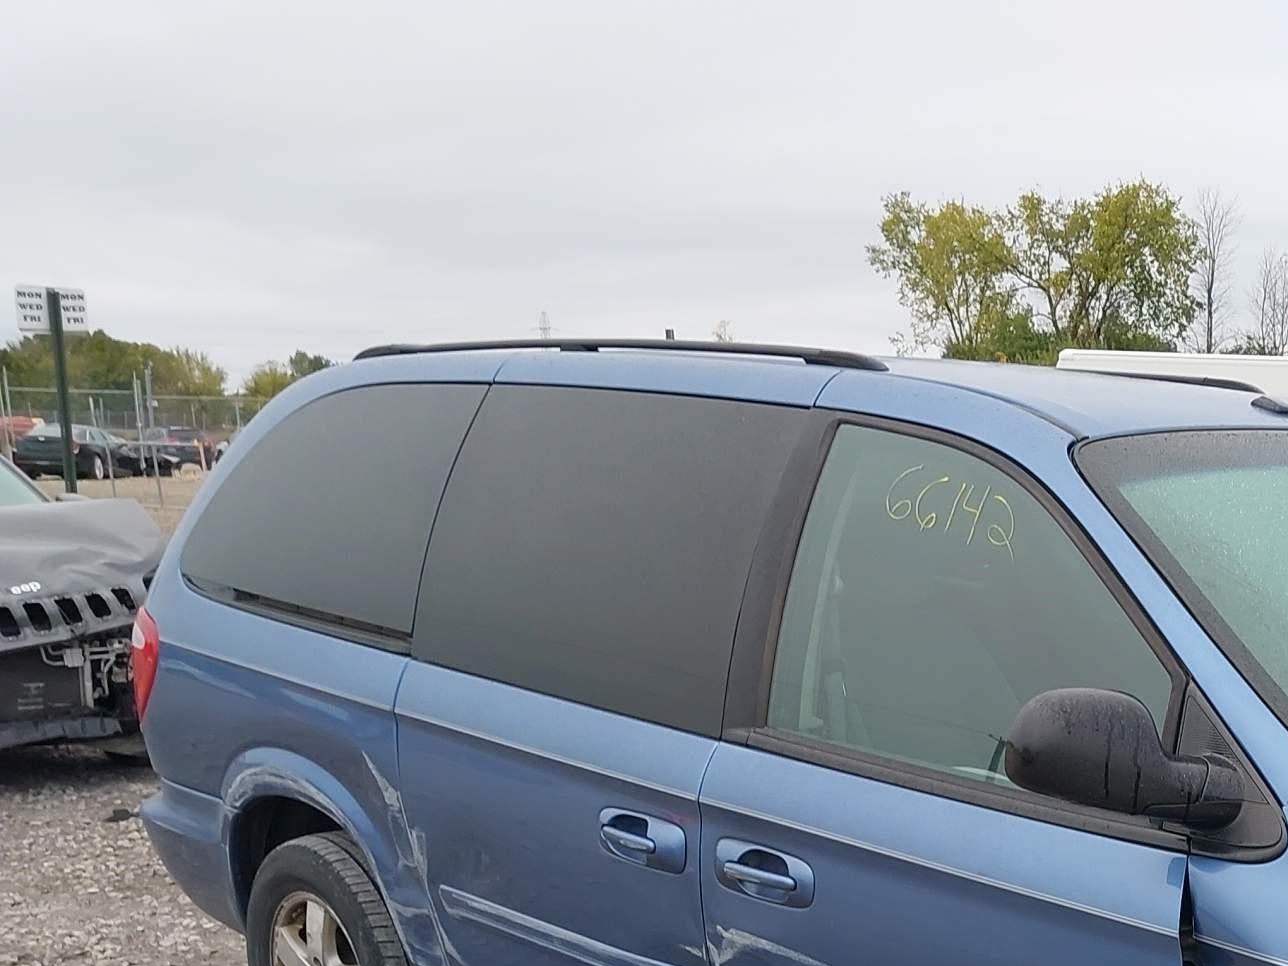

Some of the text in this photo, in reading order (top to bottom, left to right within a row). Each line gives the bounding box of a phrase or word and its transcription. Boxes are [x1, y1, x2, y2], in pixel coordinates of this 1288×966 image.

[17, 290, 42, 299] MON
[19, 303, 43, 311] WED
[886, 464, 1015, 561] 66142
